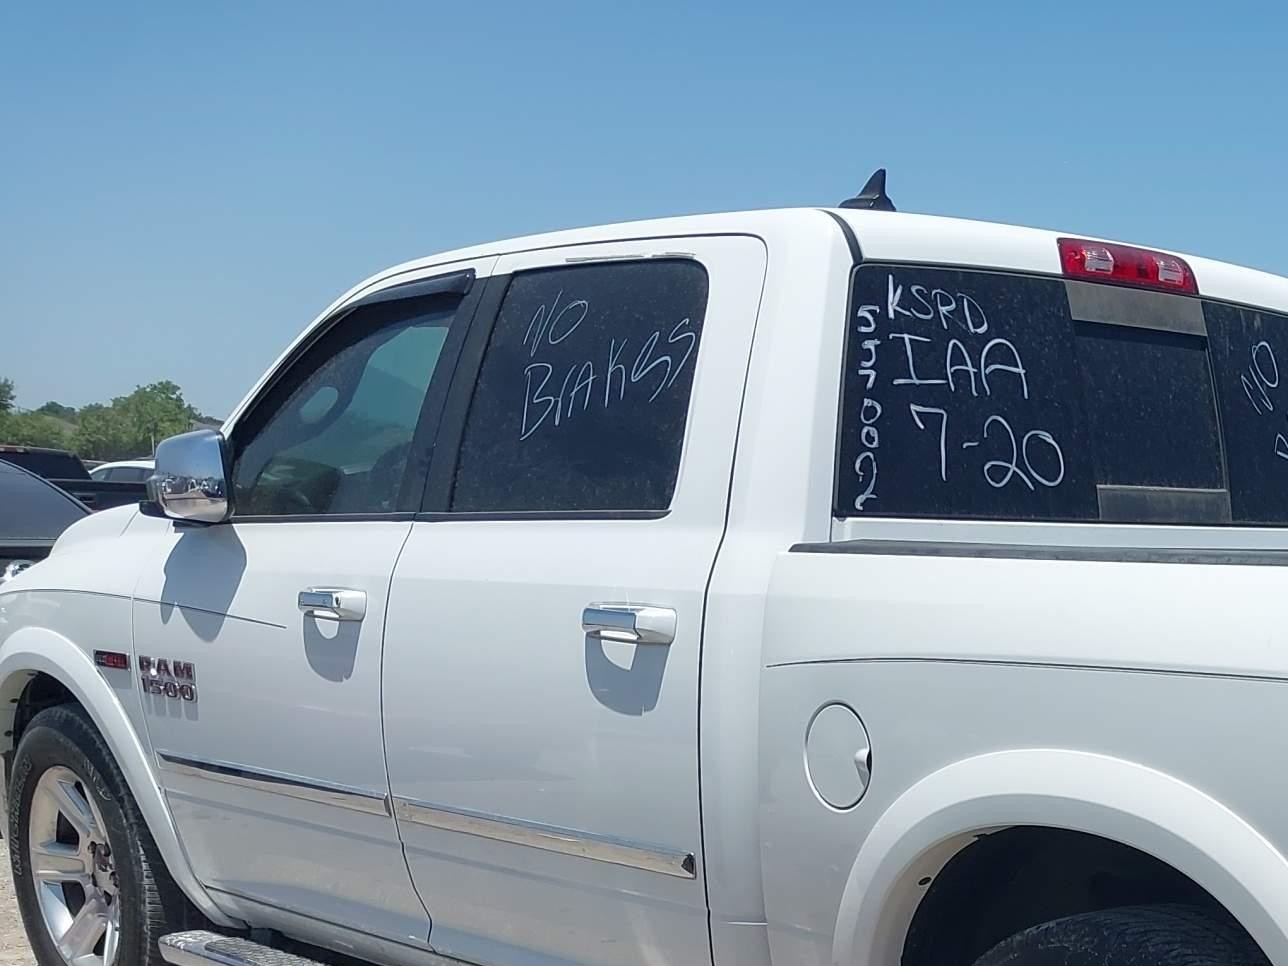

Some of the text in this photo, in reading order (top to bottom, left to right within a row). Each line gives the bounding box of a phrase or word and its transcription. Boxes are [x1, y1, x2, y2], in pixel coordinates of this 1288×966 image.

[522, 289, 588, 357] NO
[888, 274, 988, 334] KSRD
[889, 333, 1028, 399] IAA
[1241, 341, 1279, 415] NO
[910, 403, 1065, 491] 7-20
[139, 656, 197, 680] RAM
[141, 676, 198, 703] 1500
